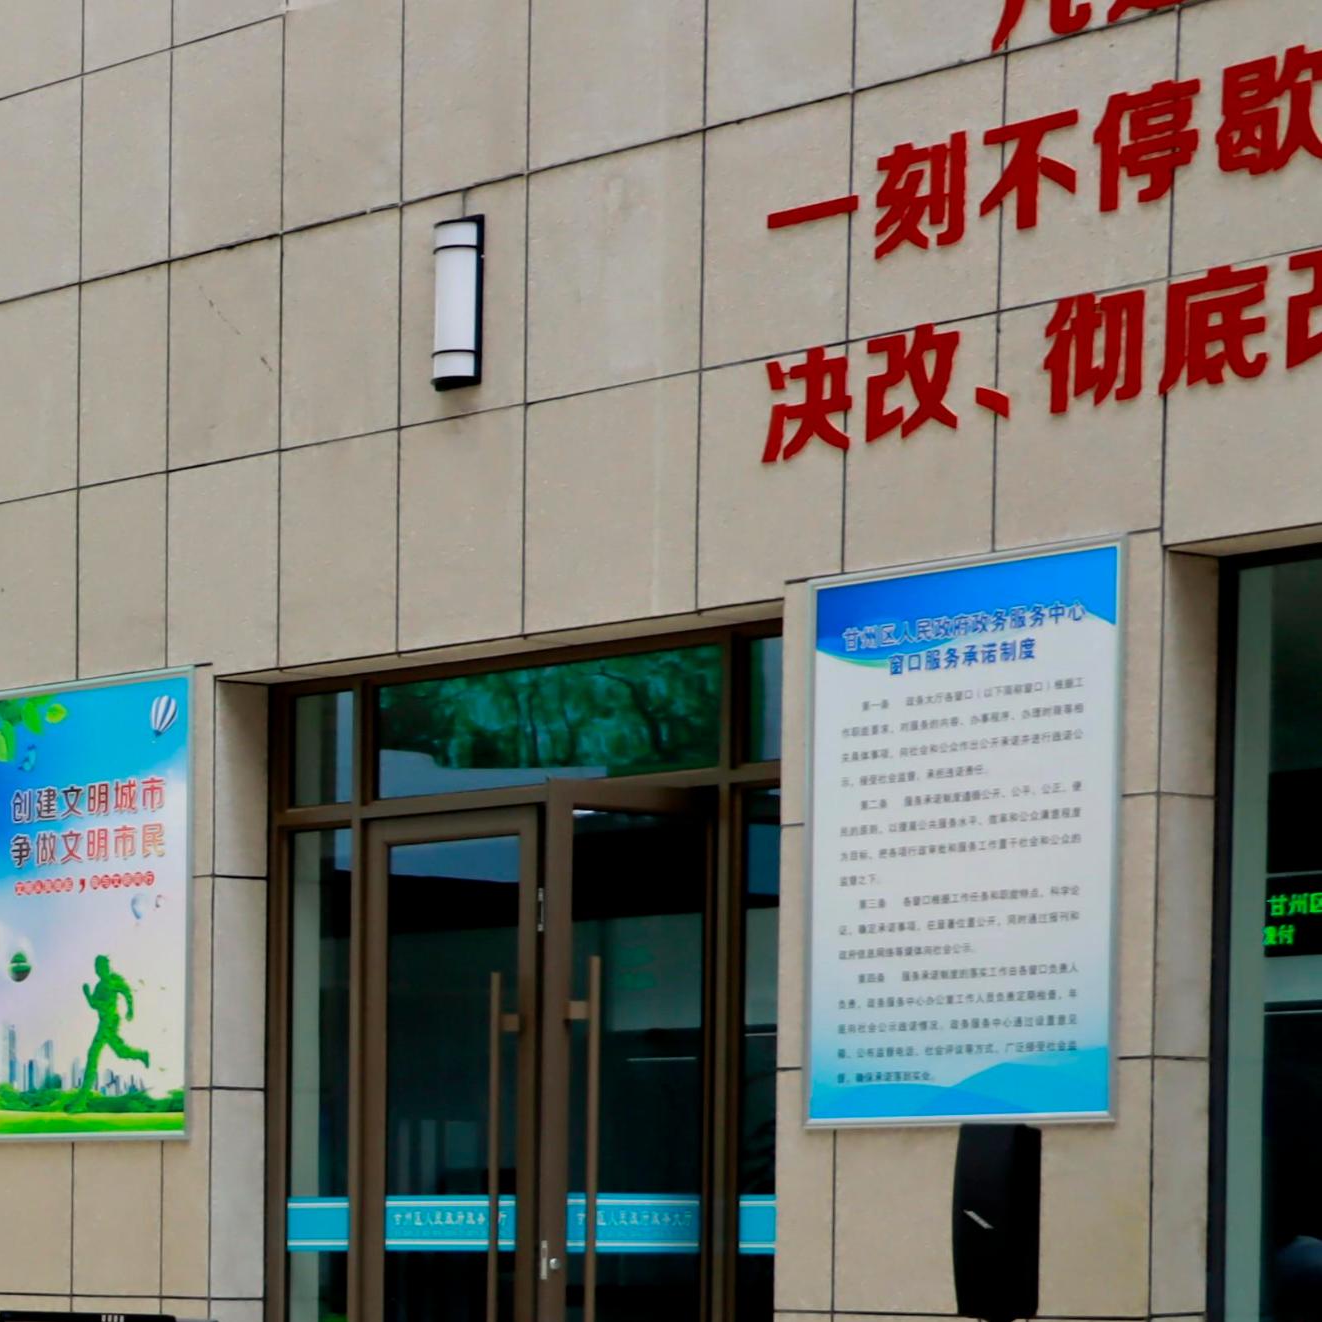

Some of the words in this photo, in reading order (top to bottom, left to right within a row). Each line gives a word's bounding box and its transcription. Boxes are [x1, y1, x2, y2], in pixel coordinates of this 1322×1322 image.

[767, 44, 1322, 260] 一刻不停歇
[888, 638, 1036, 676] 窗口服务承诺制度
[11, 775, 165, 824] 创建文明城市
[10, 822, 165, 869] 争做文明市民
